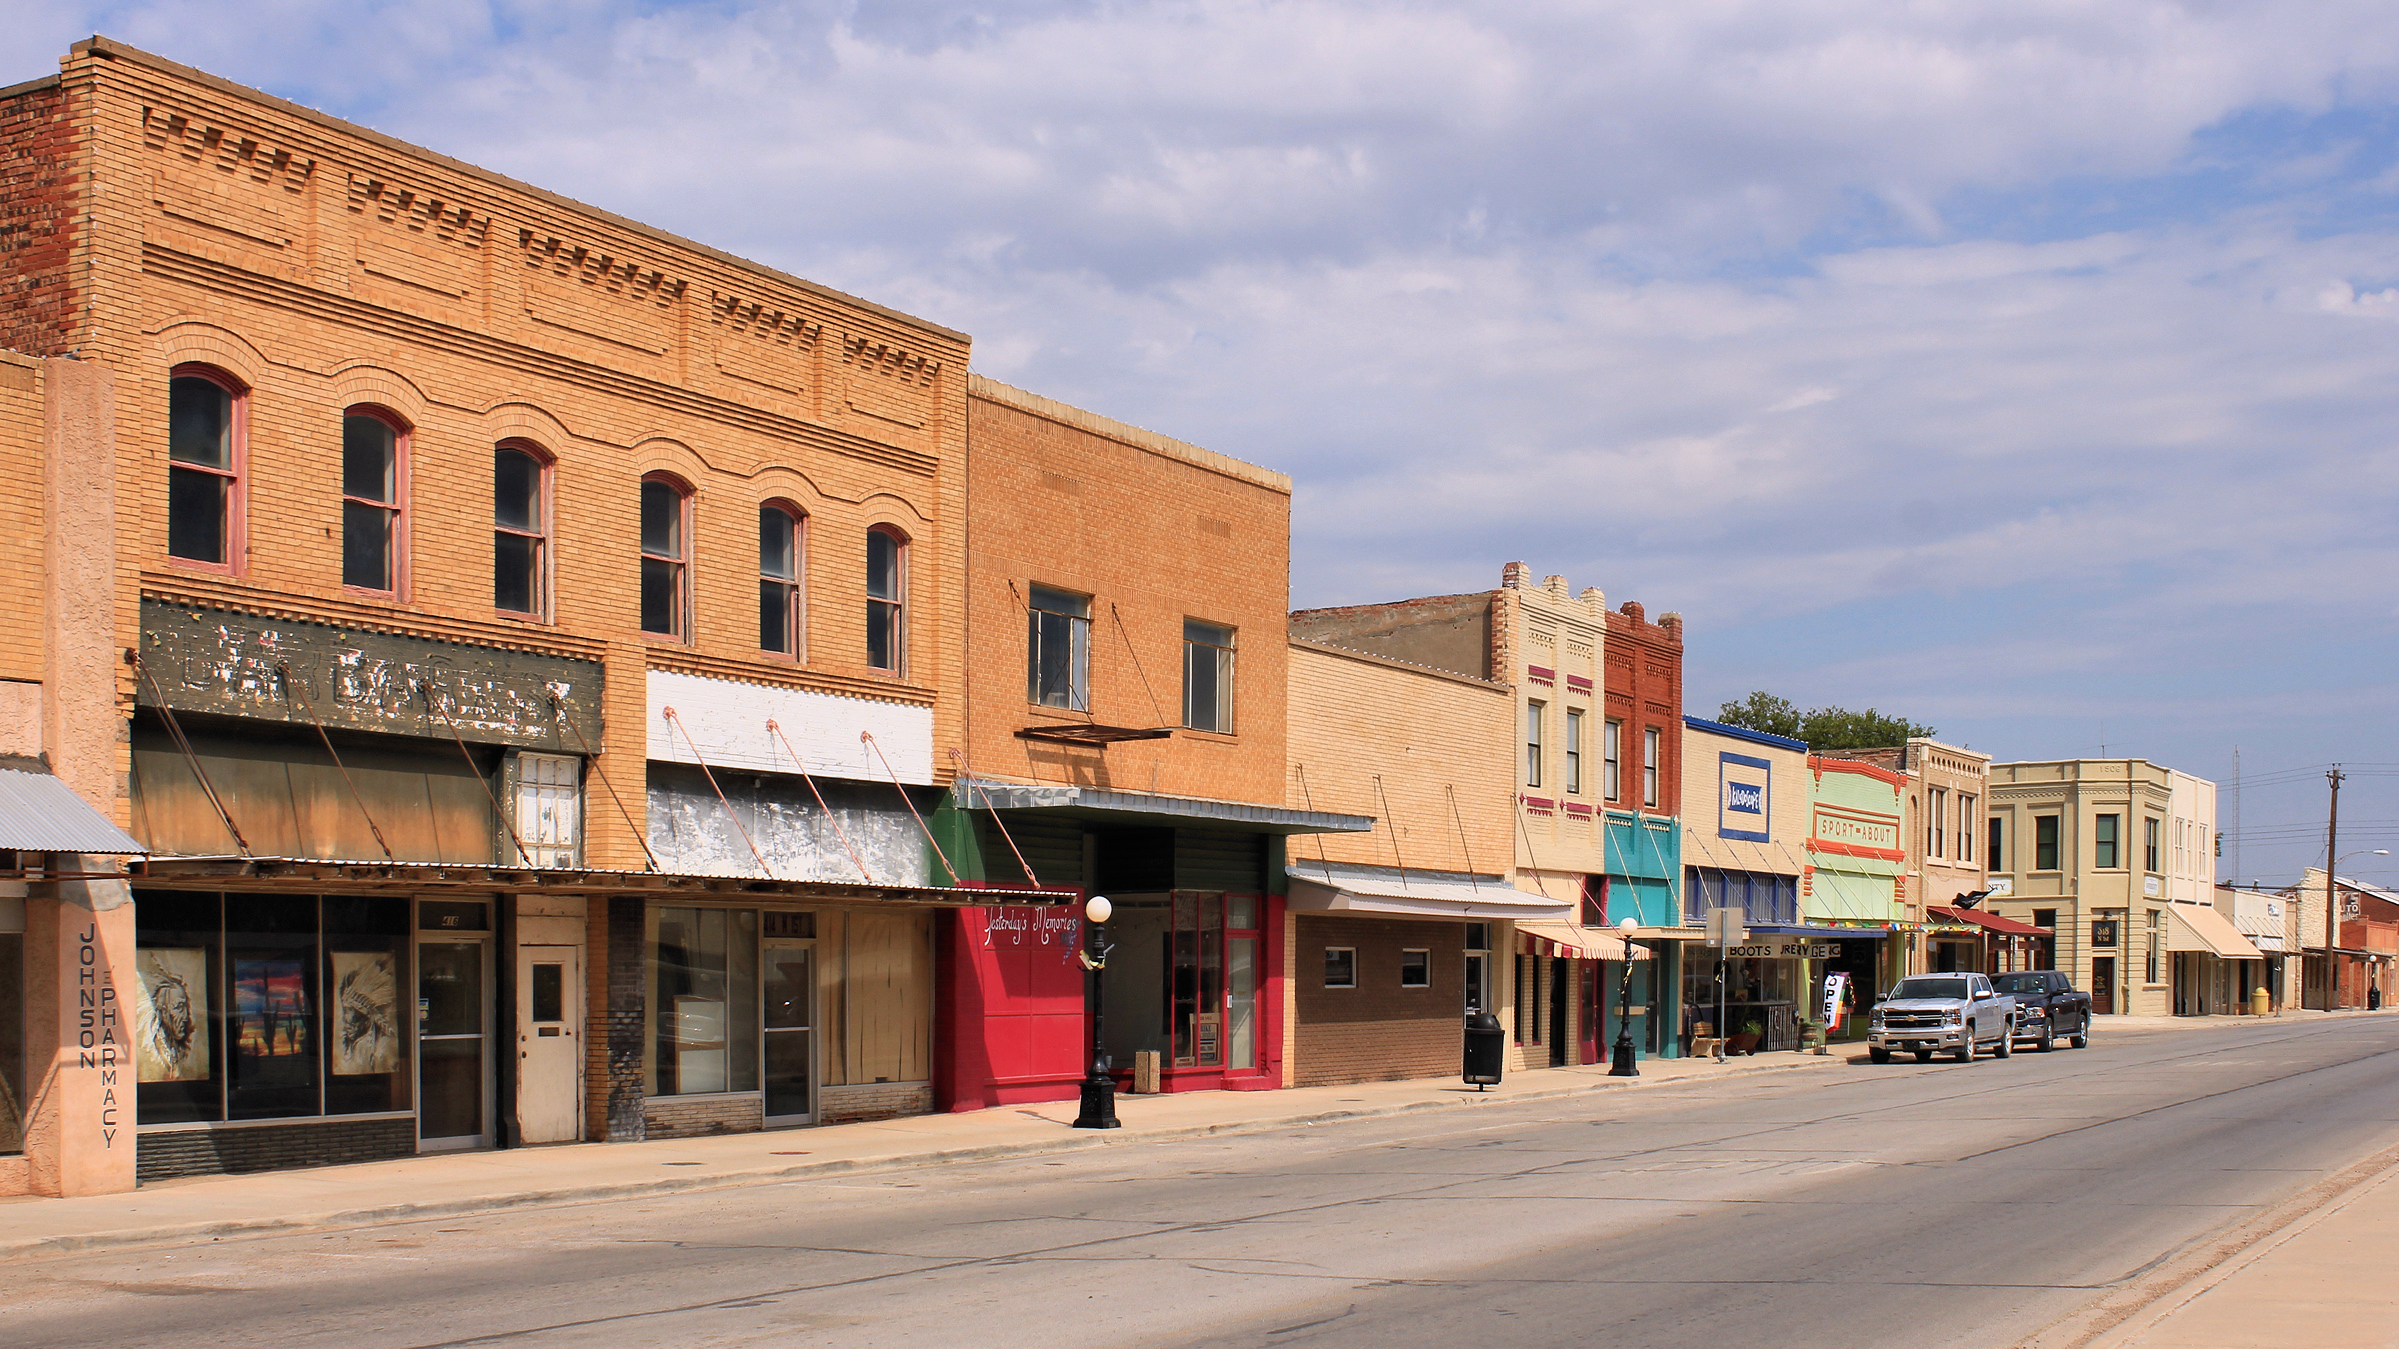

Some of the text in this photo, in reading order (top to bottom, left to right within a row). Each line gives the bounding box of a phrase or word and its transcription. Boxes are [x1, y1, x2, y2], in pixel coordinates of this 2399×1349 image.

[1822, 819, 1891, 842] SPORT-ABOUT
[442, 915, 459, 926] 416
[984, 906, 1077, 946] Yesterday's Memories
[1729, 945, 1772, 957] BOOTS
[79, 922, 95, 1069] JOHNSON
[1823, 977, 1838, 1024] OPEN
[101, 987, 117, 1149] PHARMACY
